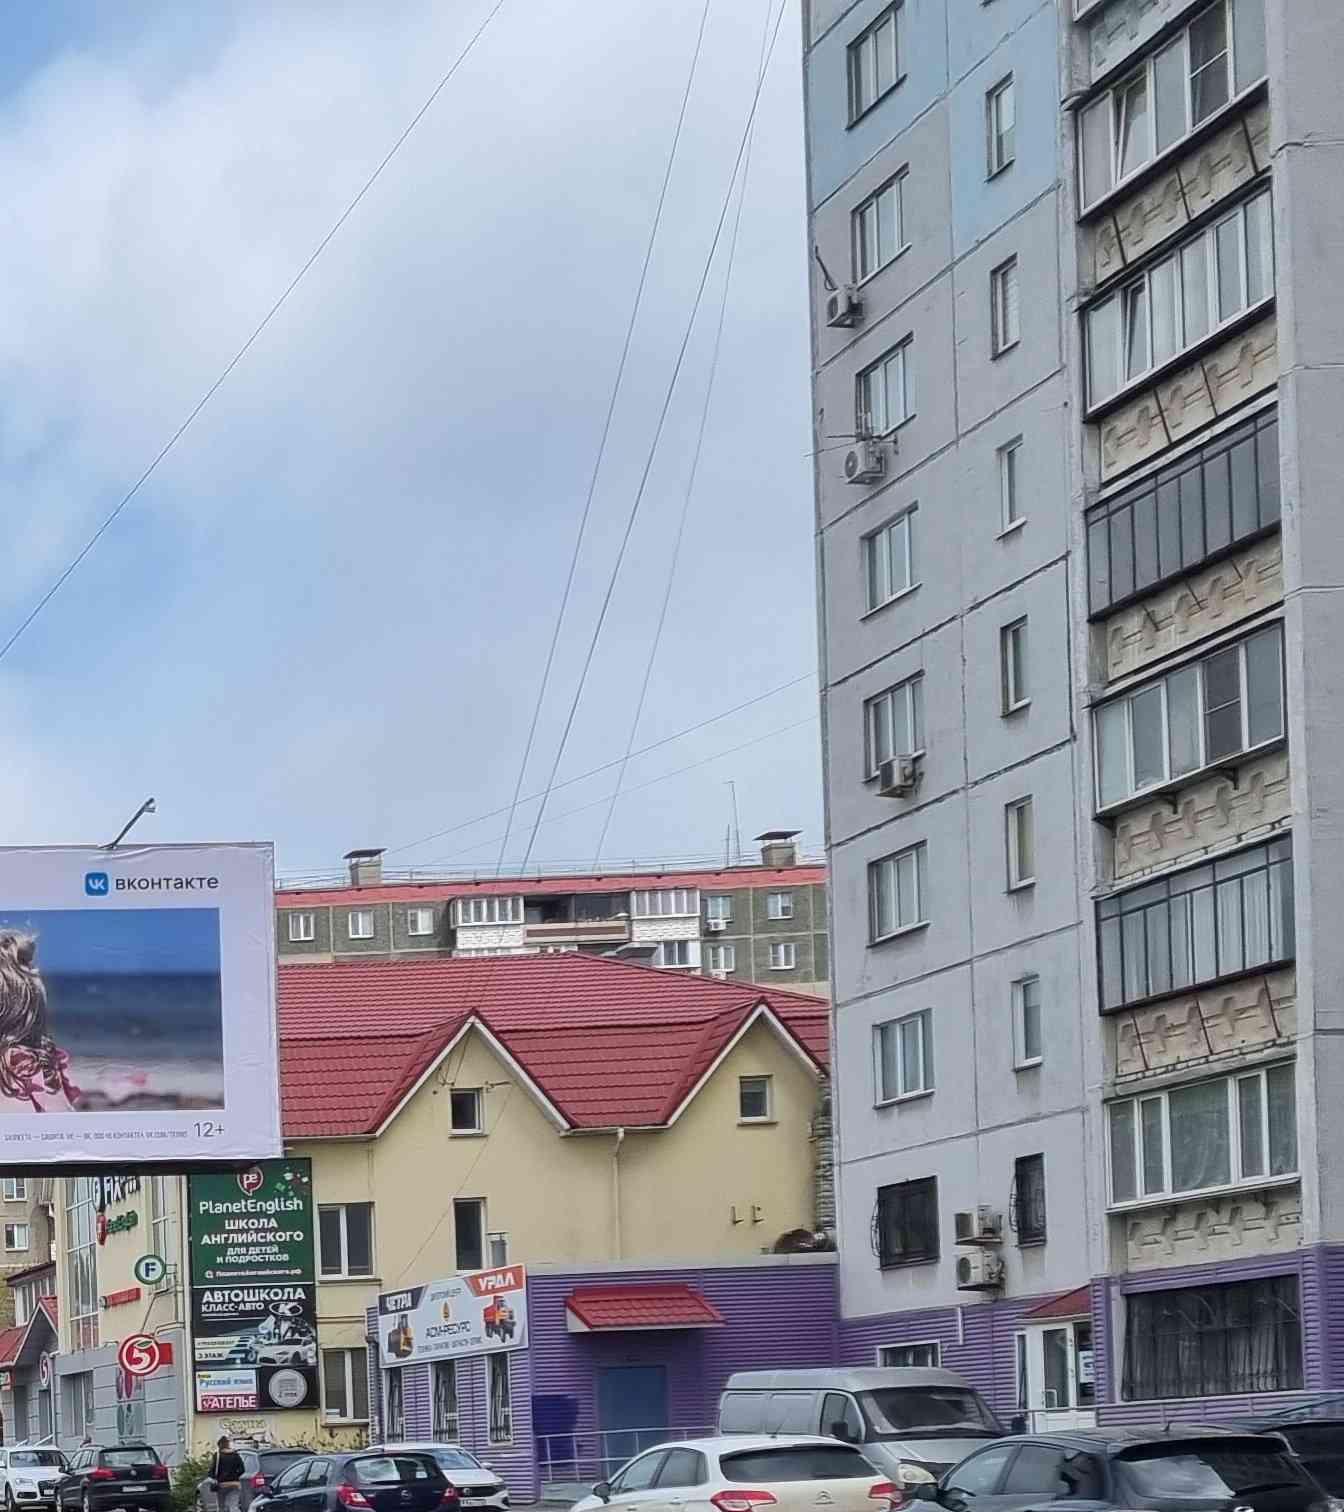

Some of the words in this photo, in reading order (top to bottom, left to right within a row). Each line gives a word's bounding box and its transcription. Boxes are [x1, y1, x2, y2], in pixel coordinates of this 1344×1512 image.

[115, 877, 219, 891] вконтакте
[193, 1122, 225, 1138] 12+
[199, 1197, 303, 1214] PlanetEnglish
[225, 1218, 278, 1230] ШКОЛА
[201, 1230, 304, 1245] АНГЛИЙСКОГО
[227, 1247, 246, 1256] ДЛЯ
[144, 1262, 156, 1277] F
[478, 1272, 516, 1291] УРАЛ
[202, 1287, 306, 1303] АВТОШКОЛА
[201, 1302, 265, 1313] КЛАСС-АВТО
[212, 1395, 257, 1408] АТЕЛЬЕ
